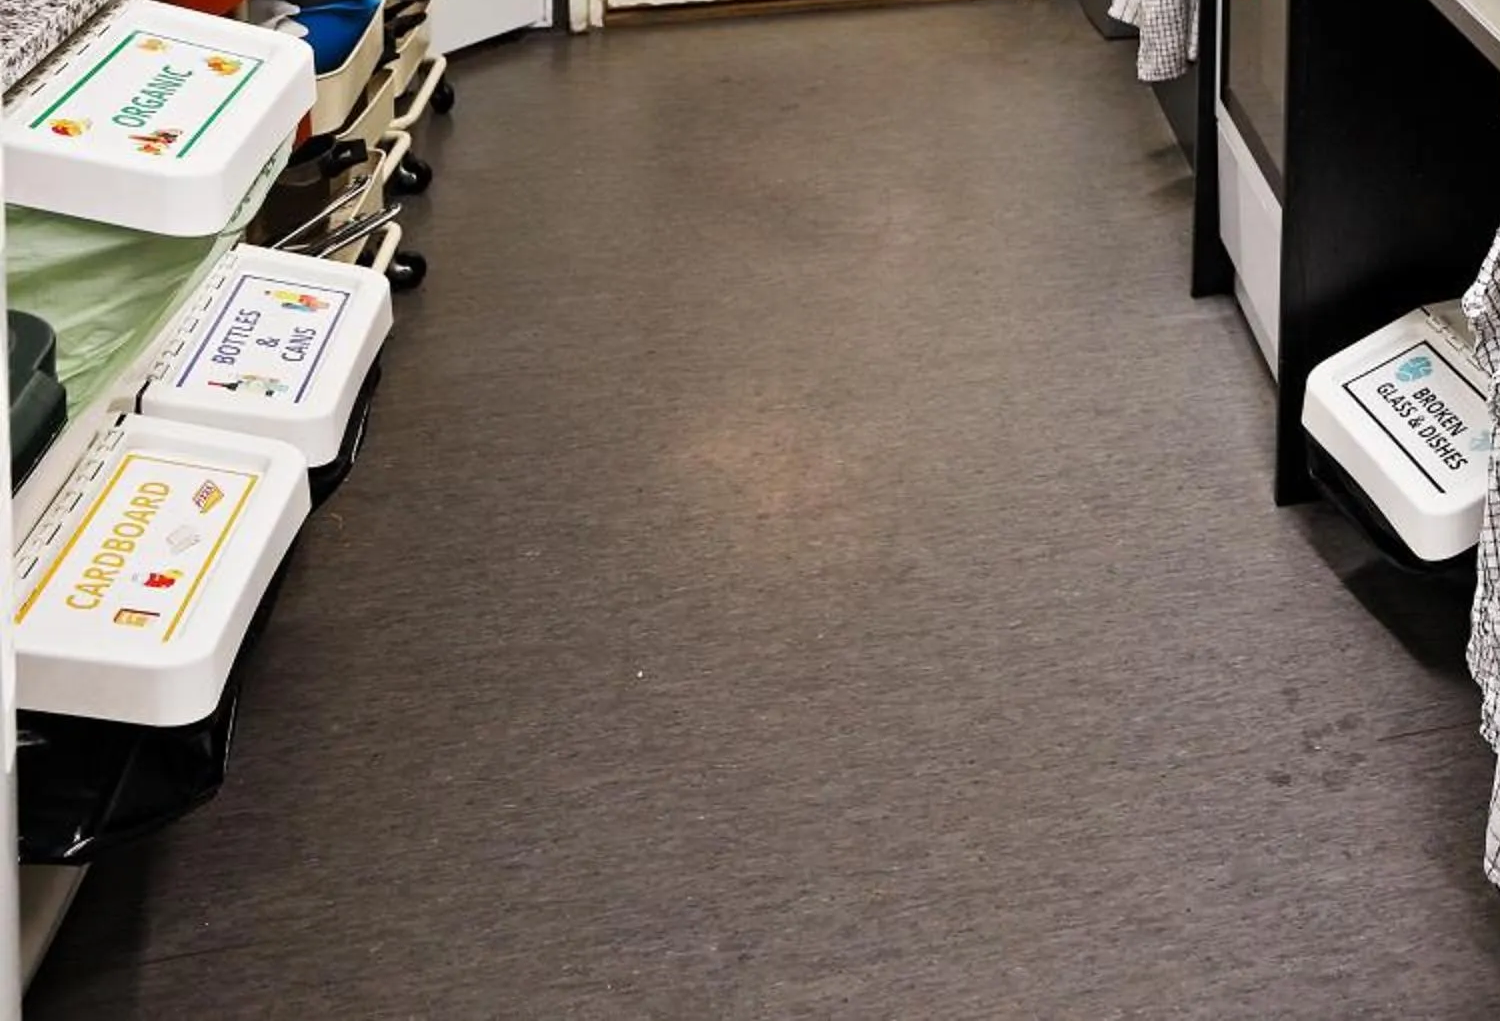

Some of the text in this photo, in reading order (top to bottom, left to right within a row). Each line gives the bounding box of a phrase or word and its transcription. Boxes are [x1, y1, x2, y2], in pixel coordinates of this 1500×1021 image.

[111, 65, 193, 128] ORGANIC
[212, 308, 261, 365] BOTTLES
[256, 336, 280, 348] &
[281, 327, 317, 362] CANS
[1377, 382, 1469, 470] GLASS & DISHES
[1412, 387, 1468, 437] BROKEN
[65, 482, 170, 610] CARDBOARD
